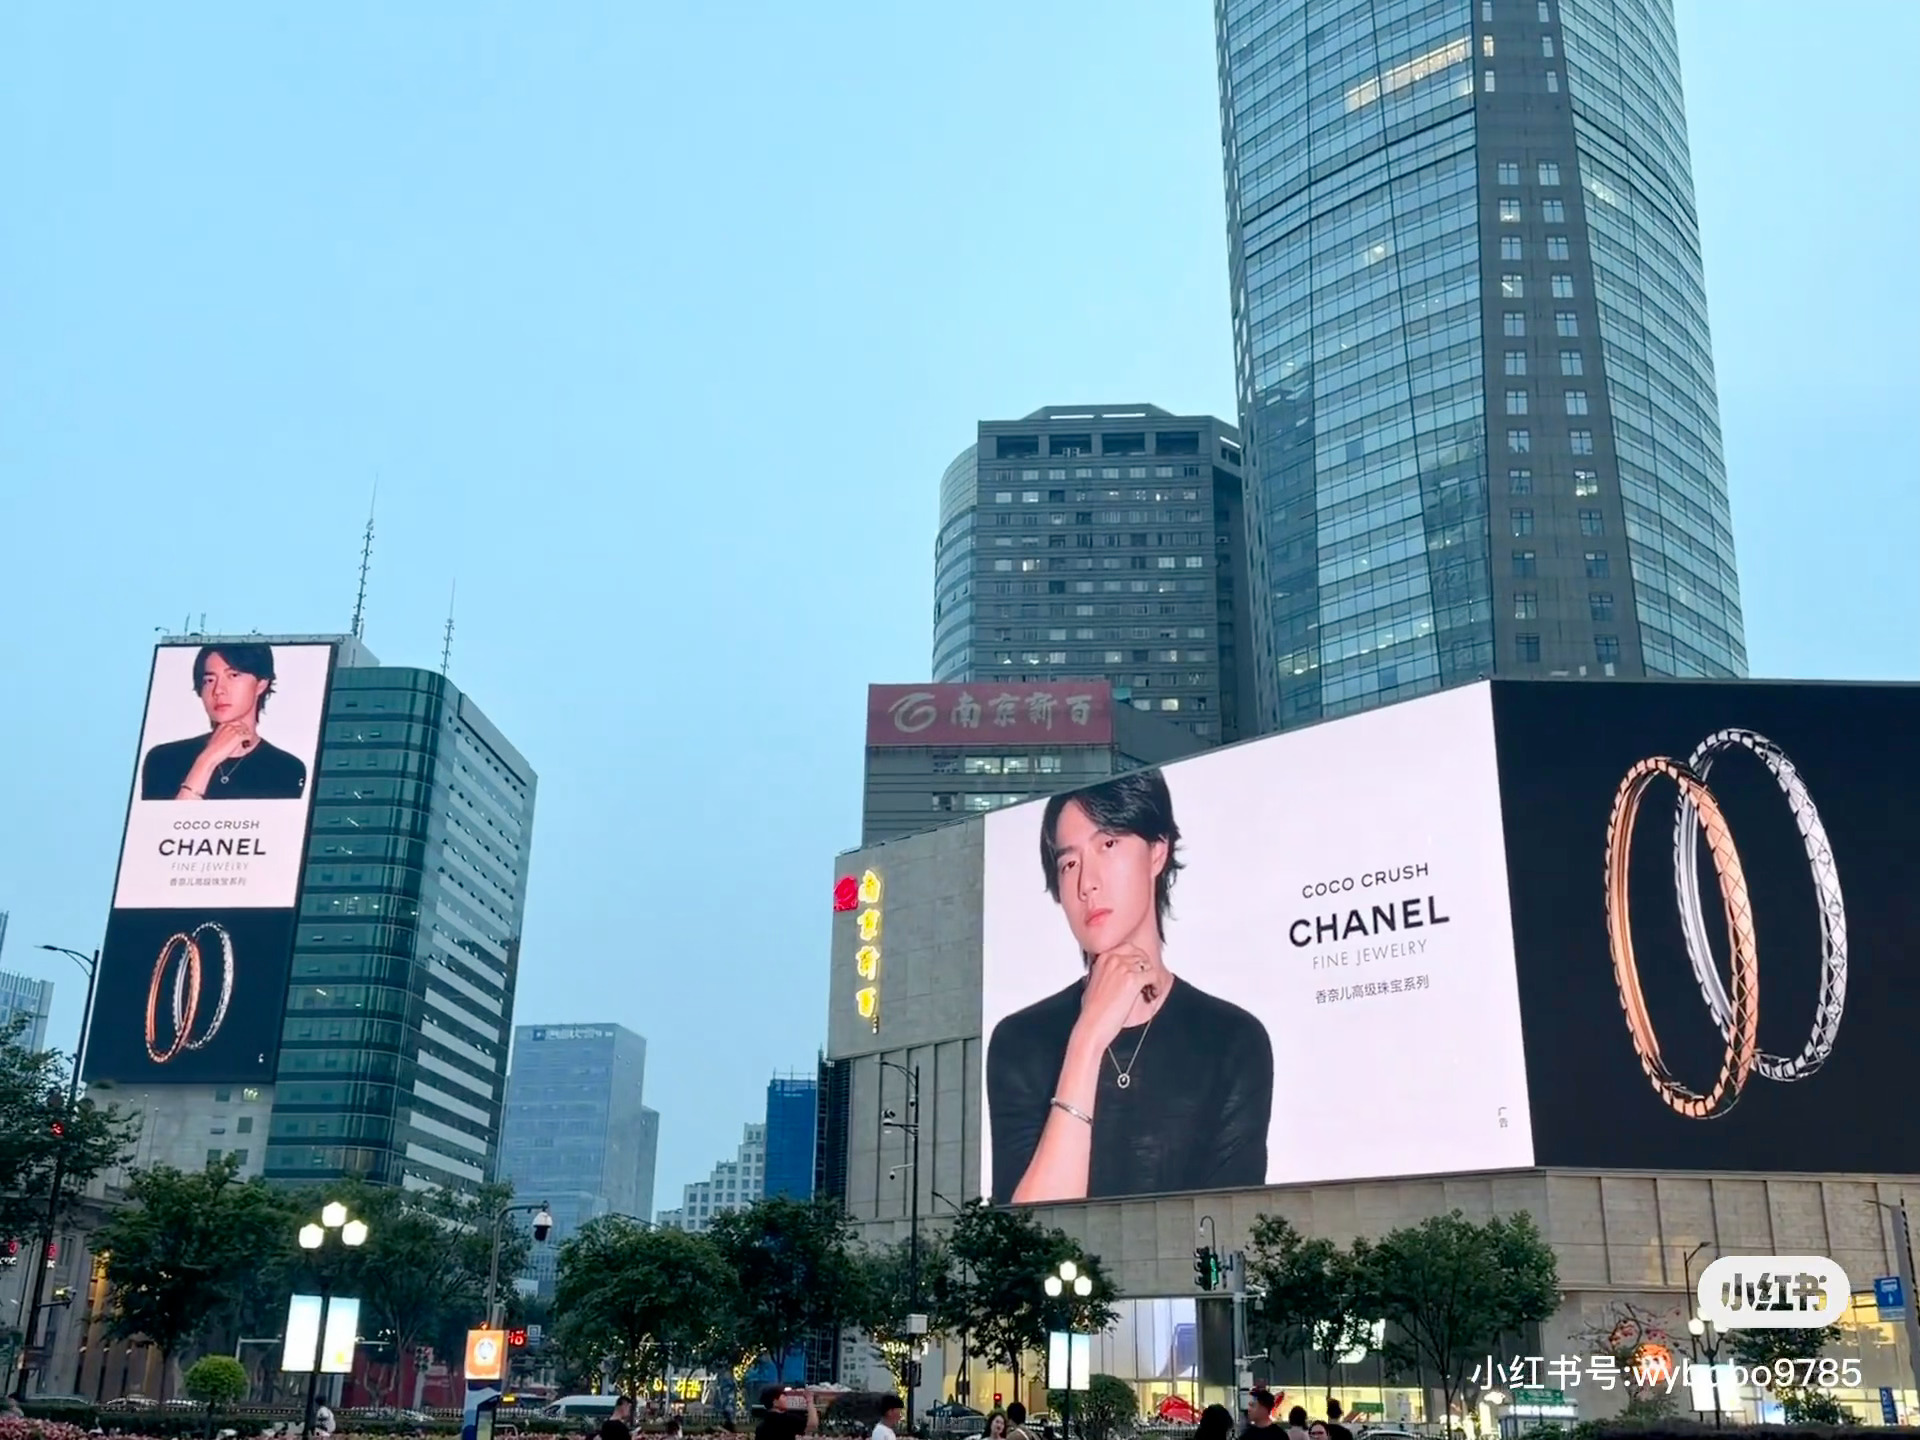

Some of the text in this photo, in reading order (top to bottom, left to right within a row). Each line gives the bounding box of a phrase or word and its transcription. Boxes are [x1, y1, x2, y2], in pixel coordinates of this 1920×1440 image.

[951, 690, 1093, 731] 南京新百
[173, 820, 260, 830] COCO CRUSH
[158, 838, 267, 856] CHANEL
[171, 862, 197, 872] FINE
[1302, 862, 1429, 899] COCO CRUSH
[1289, 895, 1450, 948] CHANEL
[1312, 938, 1428, 970] FINE JEWELRY
[1315, 974, 1430, 1005] 香奈儿高级珠宝系列
